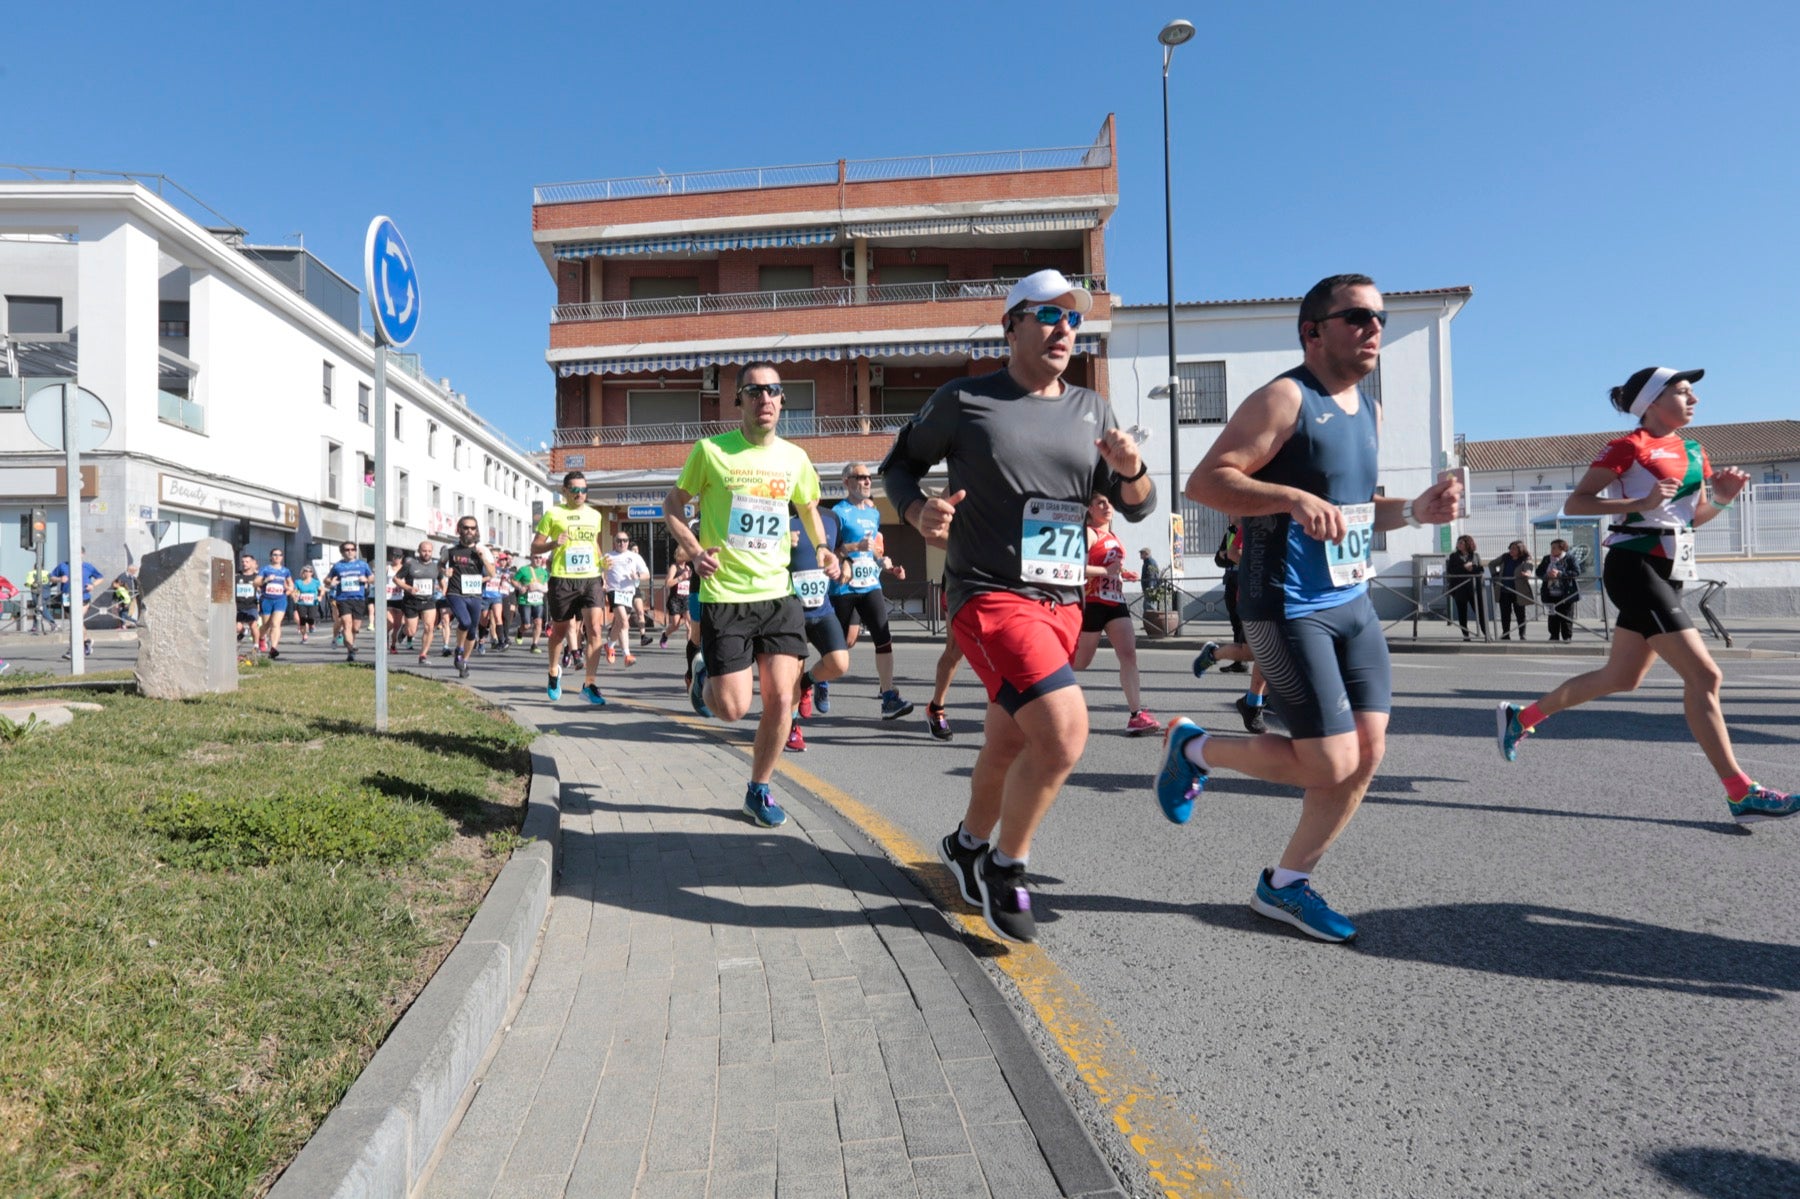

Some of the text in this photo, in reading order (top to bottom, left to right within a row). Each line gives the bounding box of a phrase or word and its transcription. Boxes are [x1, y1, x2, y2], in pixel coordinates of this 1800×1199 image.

[169, 479, 208, 505] Beauty
[616, 484, 846, 503] RESTAUR ADA
[629, 508, 656, 516] Granada
[740, 512, 780, 537] 912
[571, 554, 591, 565] 673
[801, 580, 826, 596] 993
